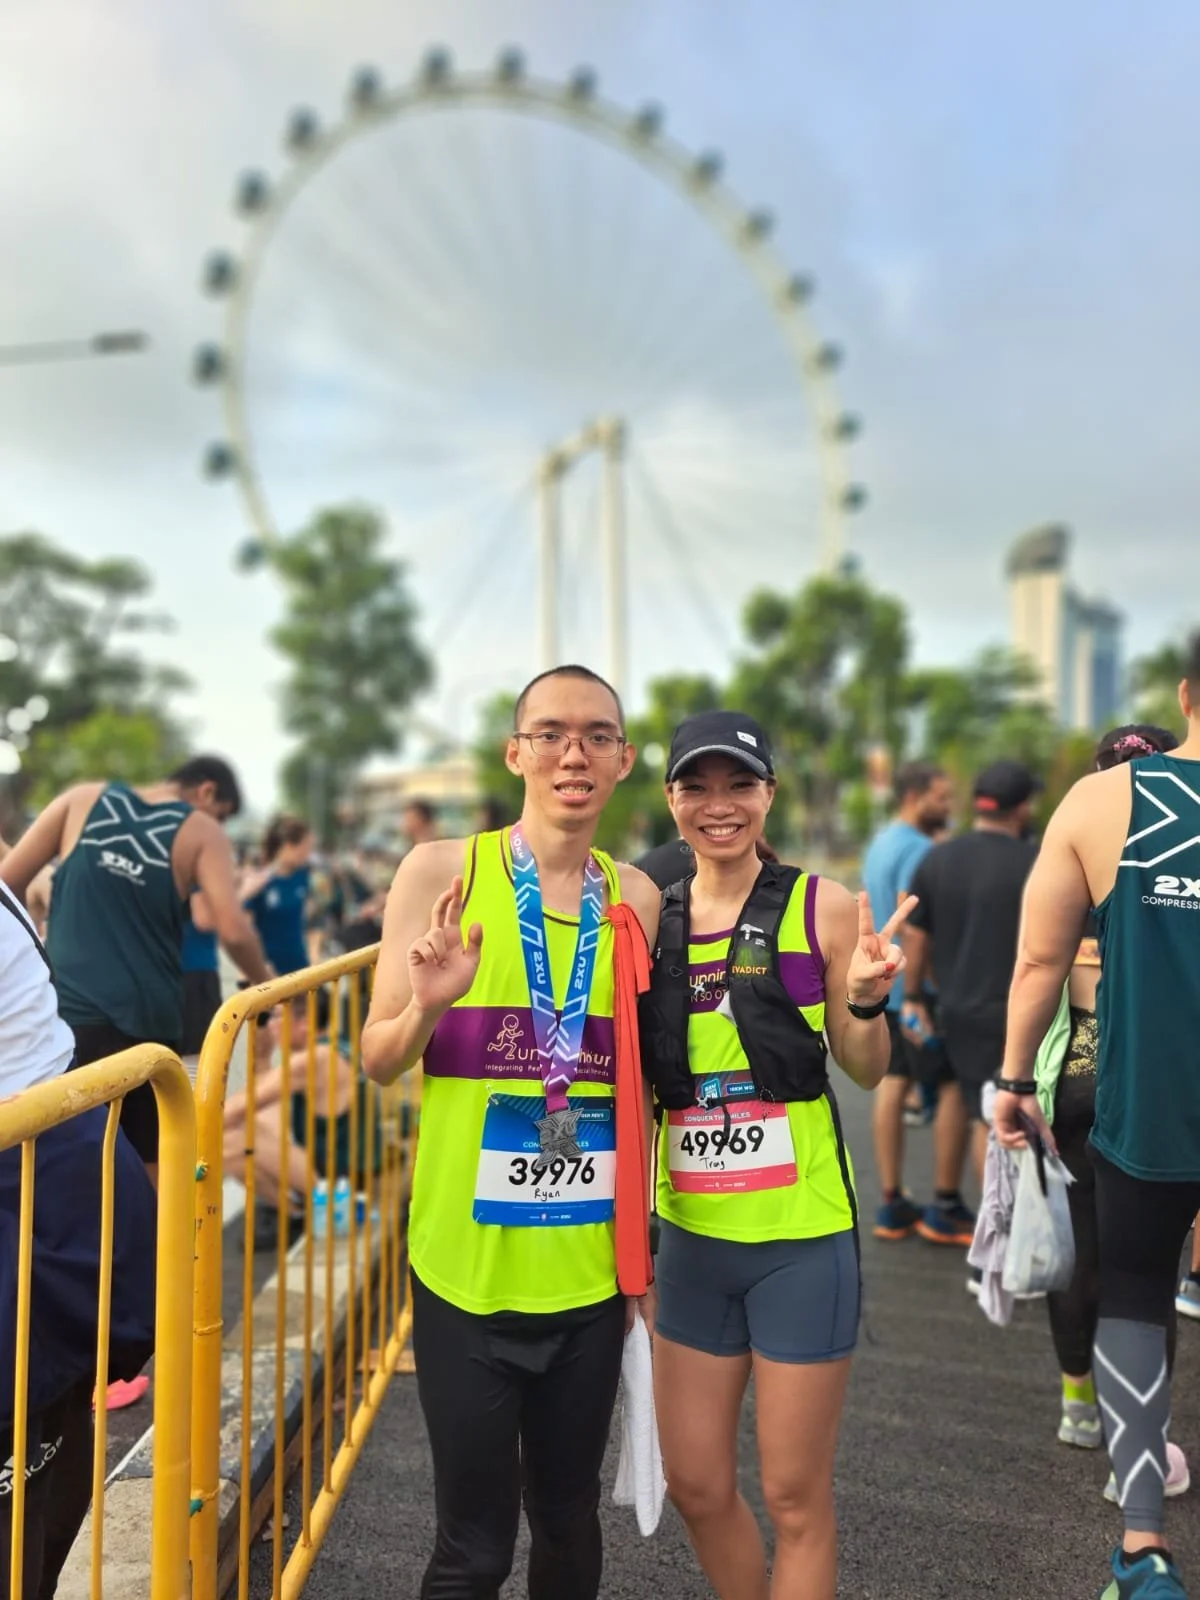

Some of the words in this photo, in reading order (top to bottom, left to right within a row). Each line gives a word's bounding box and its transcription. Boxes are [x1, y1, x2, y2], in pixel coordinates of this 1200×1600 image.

[533, 951, 546, 985] 2XU
[574, 956, 586, 990] 2XU
[484, 1063, 523, 1072] Integrating
[680, 1125, 765, 1157] 49969
[508, 1156, 596, 1186] 39976
[534, 1187, 561, 1202] Ryan
